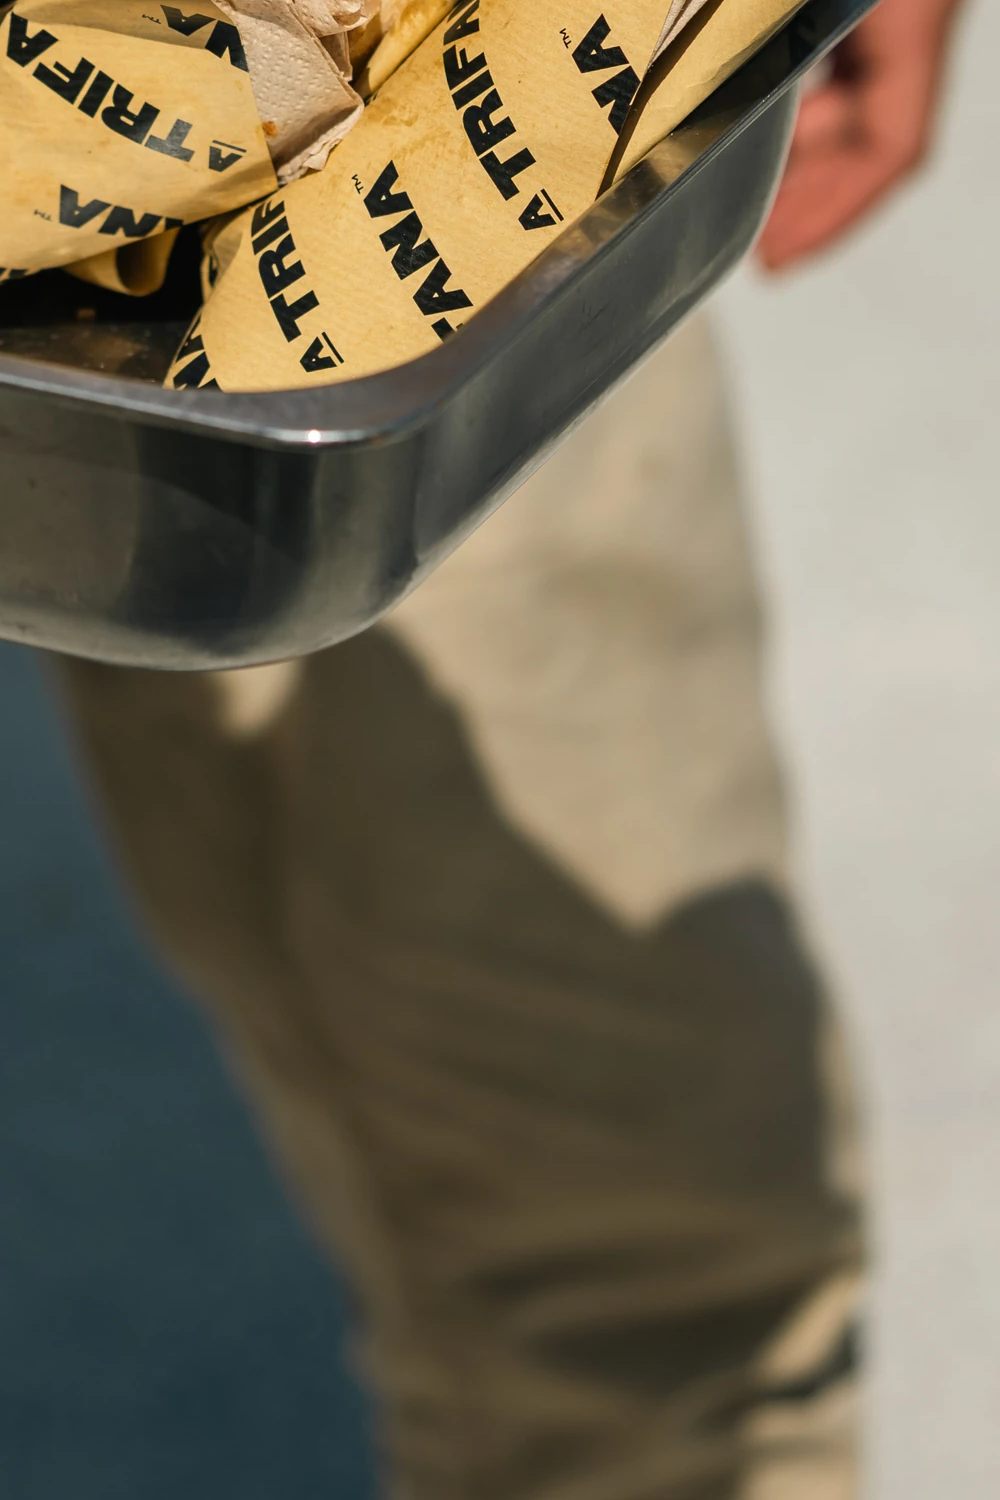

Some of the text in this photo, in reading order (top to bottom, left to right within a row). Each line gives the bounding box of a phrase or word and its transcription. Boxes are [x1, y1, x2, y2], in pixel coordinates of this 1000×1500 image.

[208, 140, 247, 173] A
[518, 188, 564, 231] A
[299, 331, 344, 373] A
